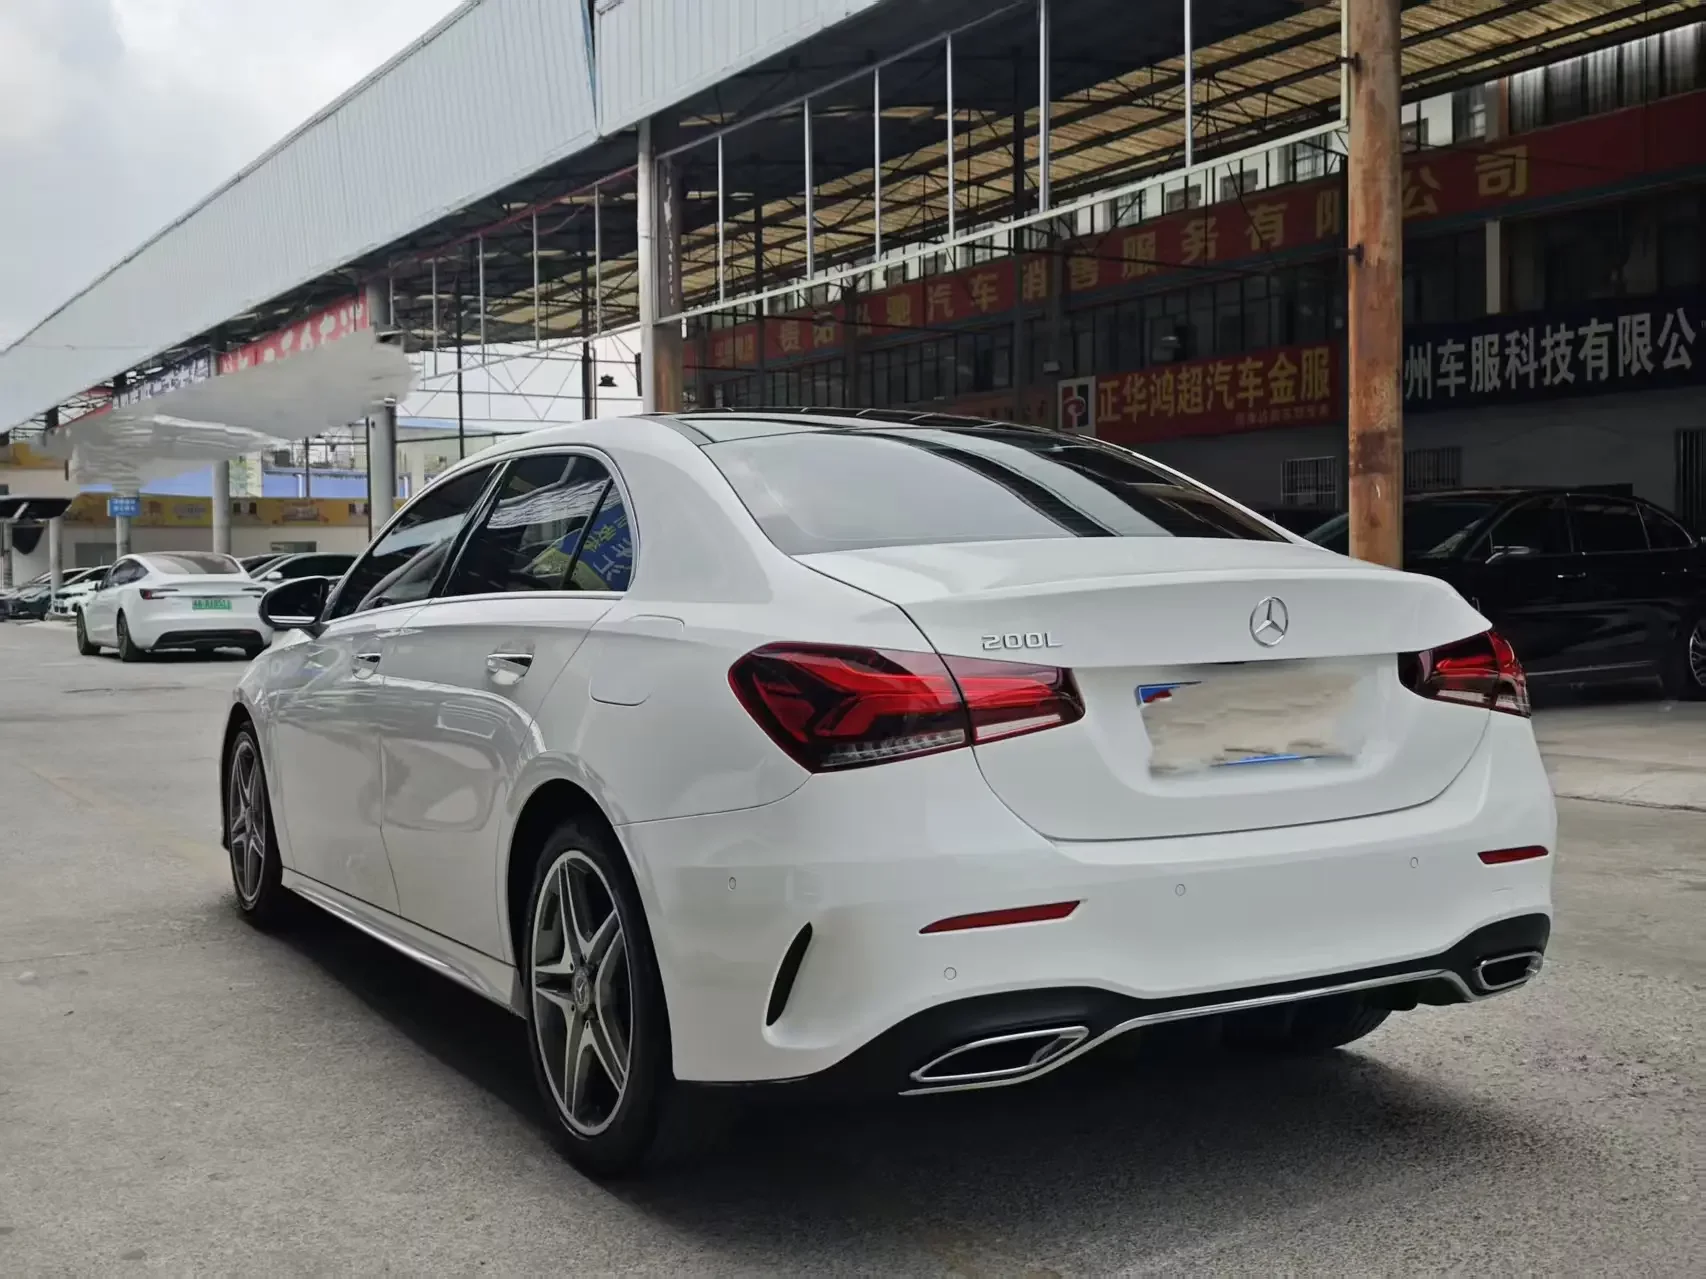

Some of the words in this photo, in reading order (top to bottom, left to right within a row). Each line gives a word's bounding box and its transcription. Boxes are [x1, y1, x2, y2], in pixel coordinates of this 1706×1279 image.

[1097, 346, 1331, 424] 正华鸿超汽车金服
[1404, 307, 1697, 401] 州车服科技有限公
[981, 632, 1064, 650] 200L
